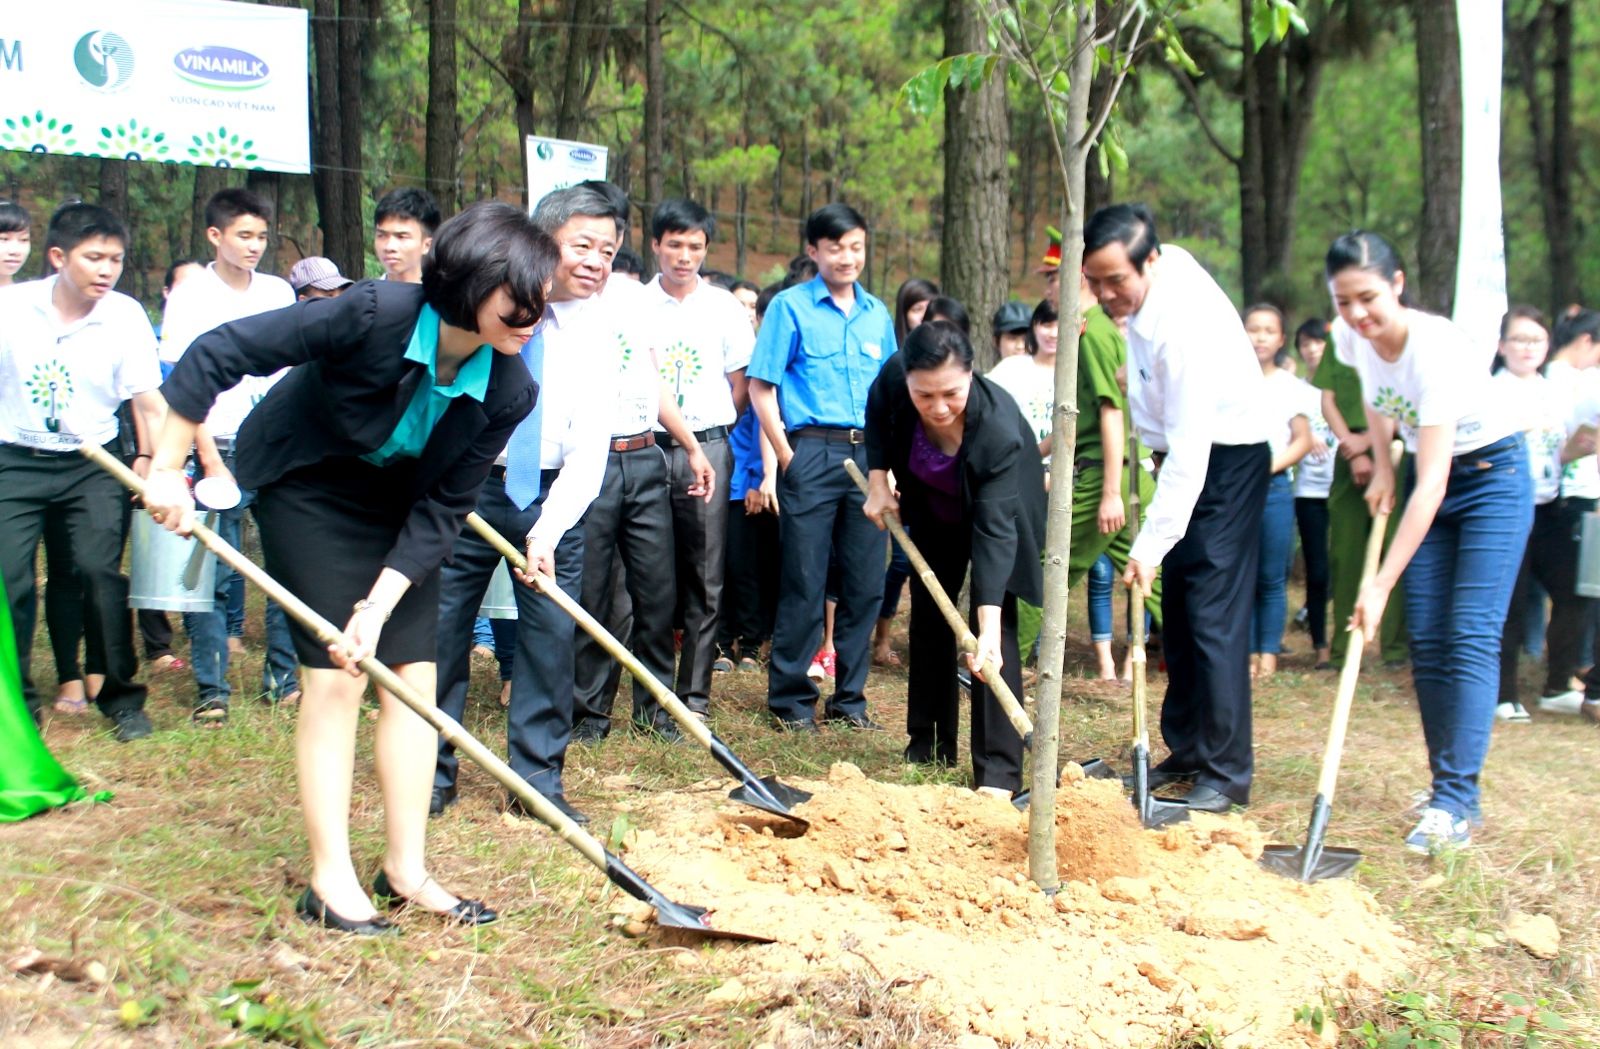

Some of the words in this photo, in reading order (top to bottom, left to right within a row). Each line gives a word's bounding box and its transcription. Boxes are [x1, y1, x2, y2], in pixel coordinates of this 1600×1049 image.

[179, 53, 265, 77] VINAMILK
[202, 98, 225, 108] CAO
[251, 103, 276, 112] NAM
